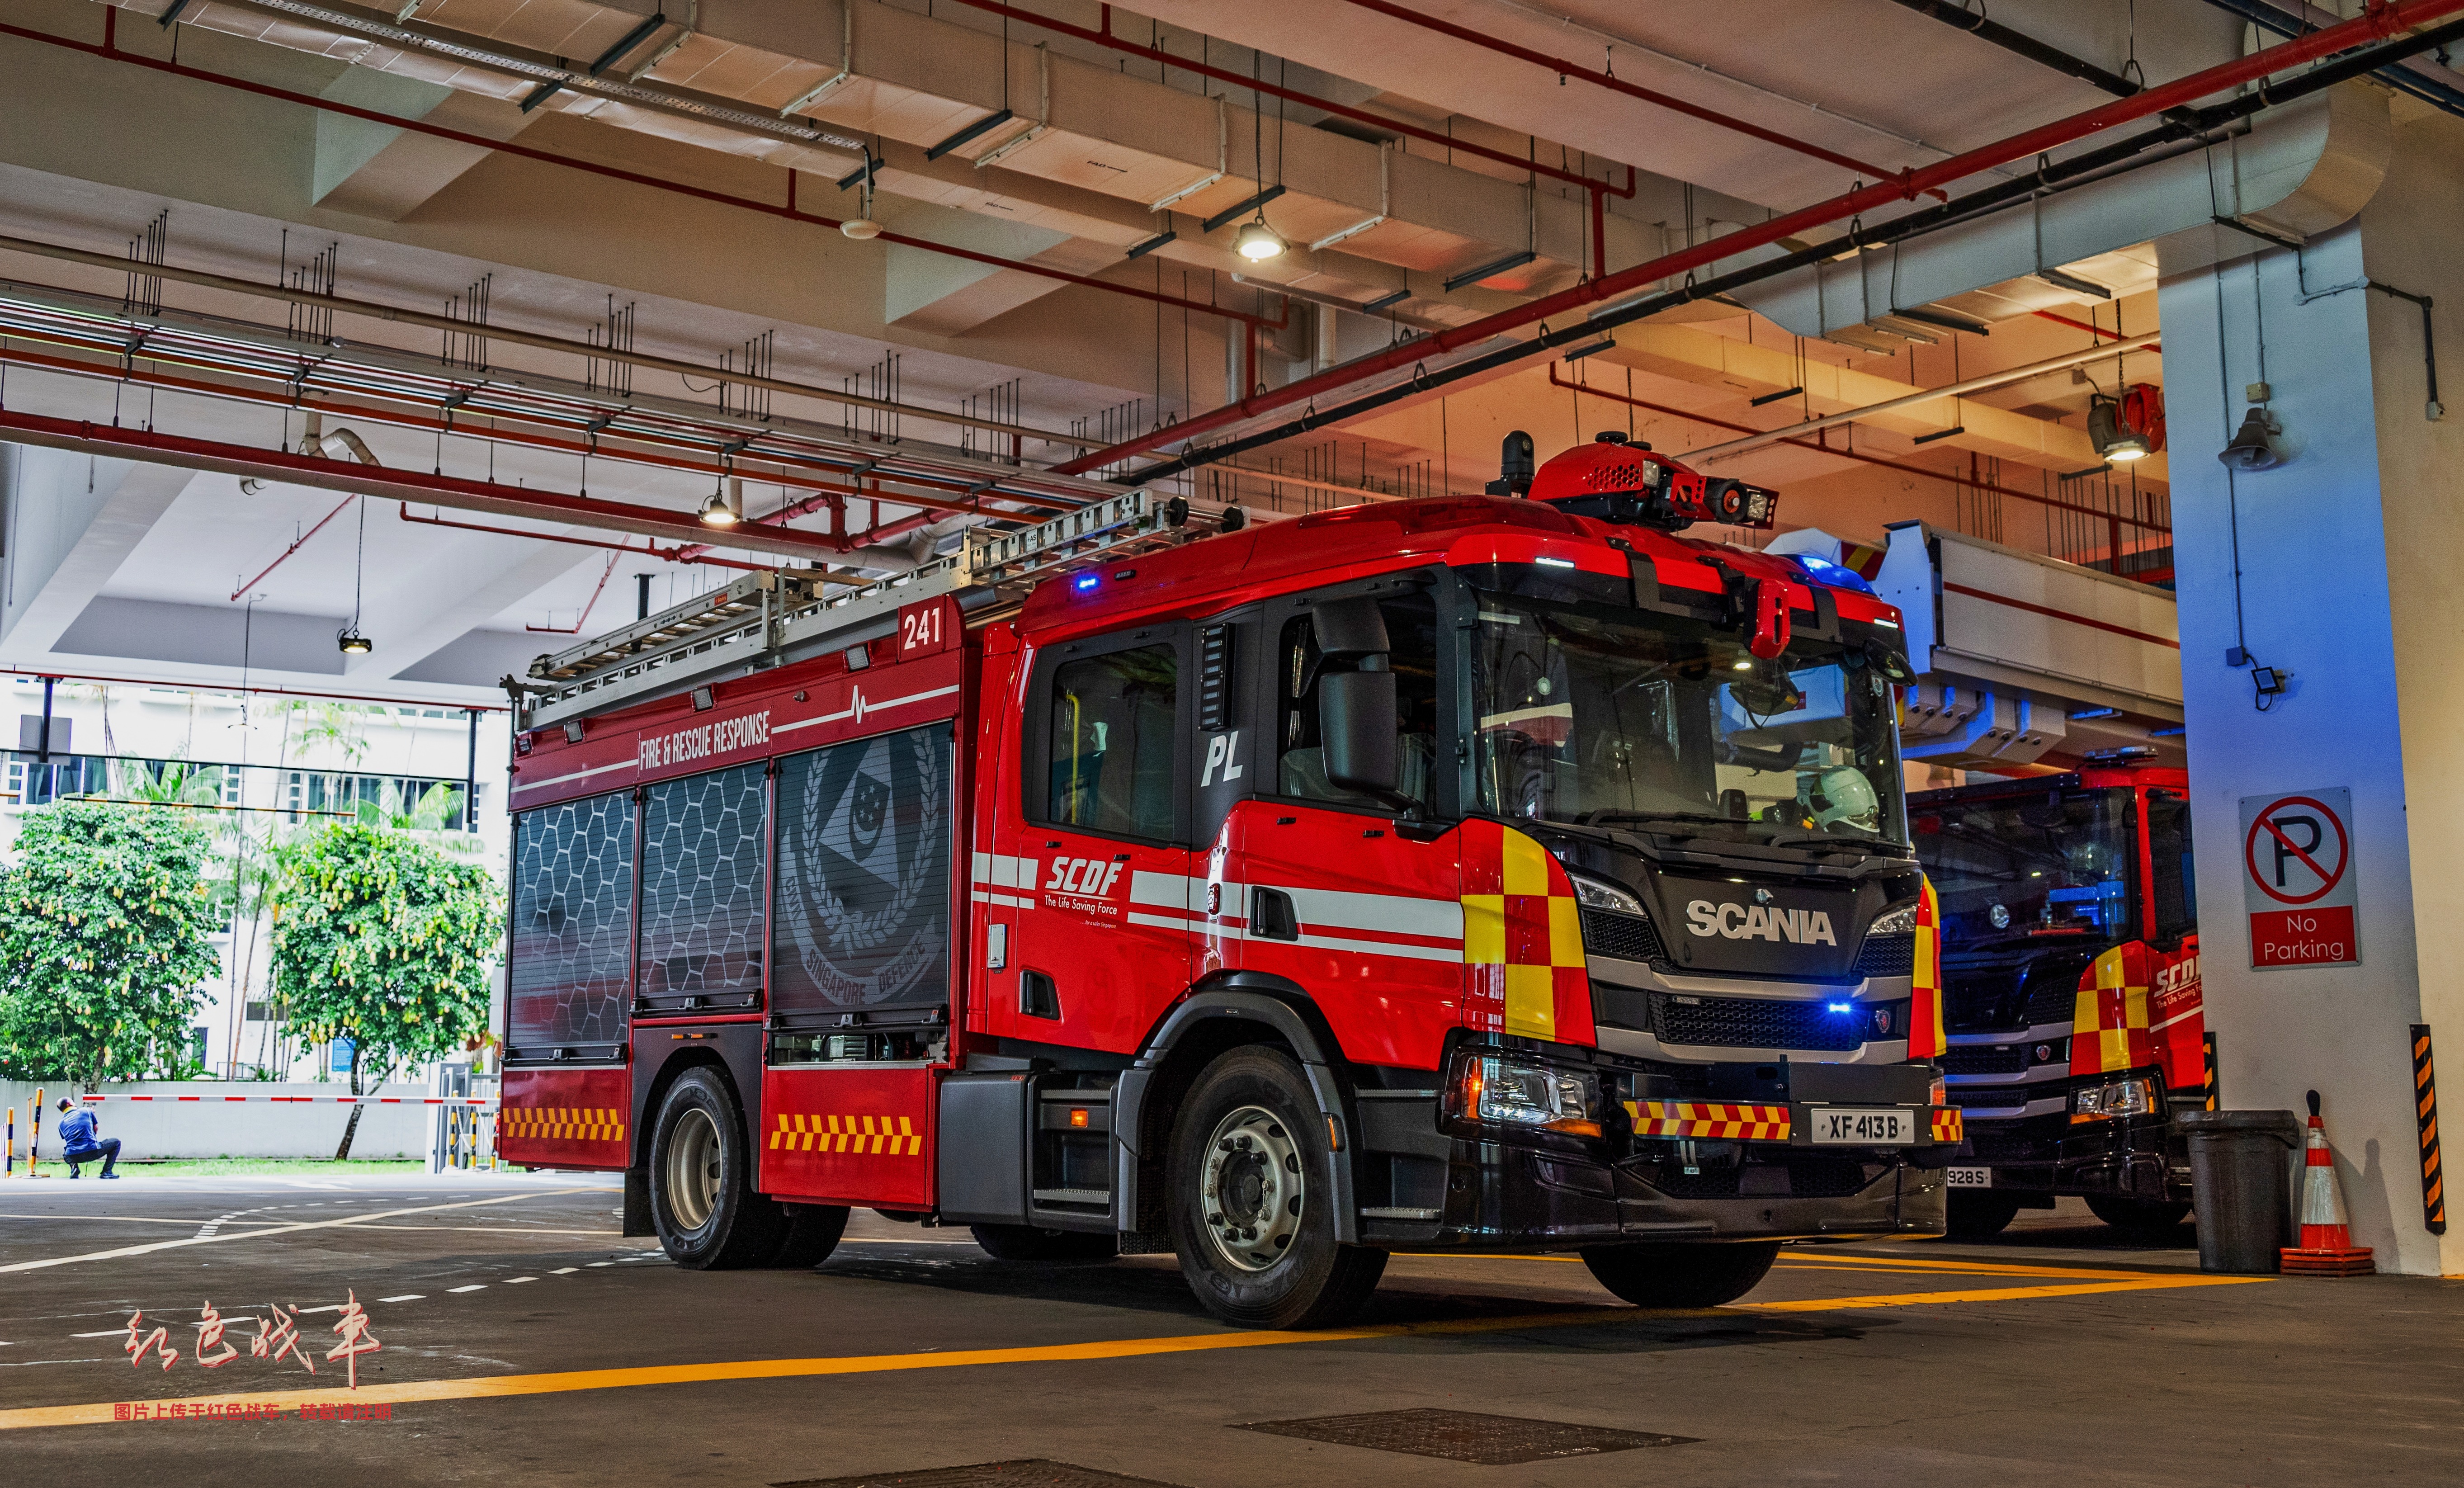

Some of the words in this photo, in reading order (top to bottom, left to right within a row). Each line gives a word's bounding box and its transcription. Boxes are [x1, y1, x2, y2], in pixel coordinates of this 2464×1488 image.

[904, 607, 939, 650] 241
[640, 737, 661, 770] FIRE
[663, 734, 670, 765] &
[672, 724, 711, 763] RESCUE
[713, 710, 769, 754] RESPONSE
[1200, 730, 1243, 787] PL
[1045, 856, 1124, 896] SCDF
[1045, 894, 1056, 907] The
[1058, 896, 1070, 909] Life
[1072, 898, 1095, 915] Saving
[1097, 902, 1118, 915] Force
[1686, 900, 1837, 946] SCANIA
[2287, 915, 2317, 933] No
[807, 949, 866, 1005] SINGAPORE
[878, 935, 925, 993] DEFENCE
[2264, 939, 2344, 961] Parking
[2156, 1000, 2167, 1009] The
[2167, 994, 2177, 1004] Life
[2177, 989, 2195, 1000] Saving
[1829, 1115, 1852, 1138] XF
[1856, 1115, 1884, 1139] 413
[1888, 1116, 1898, 1139] B
